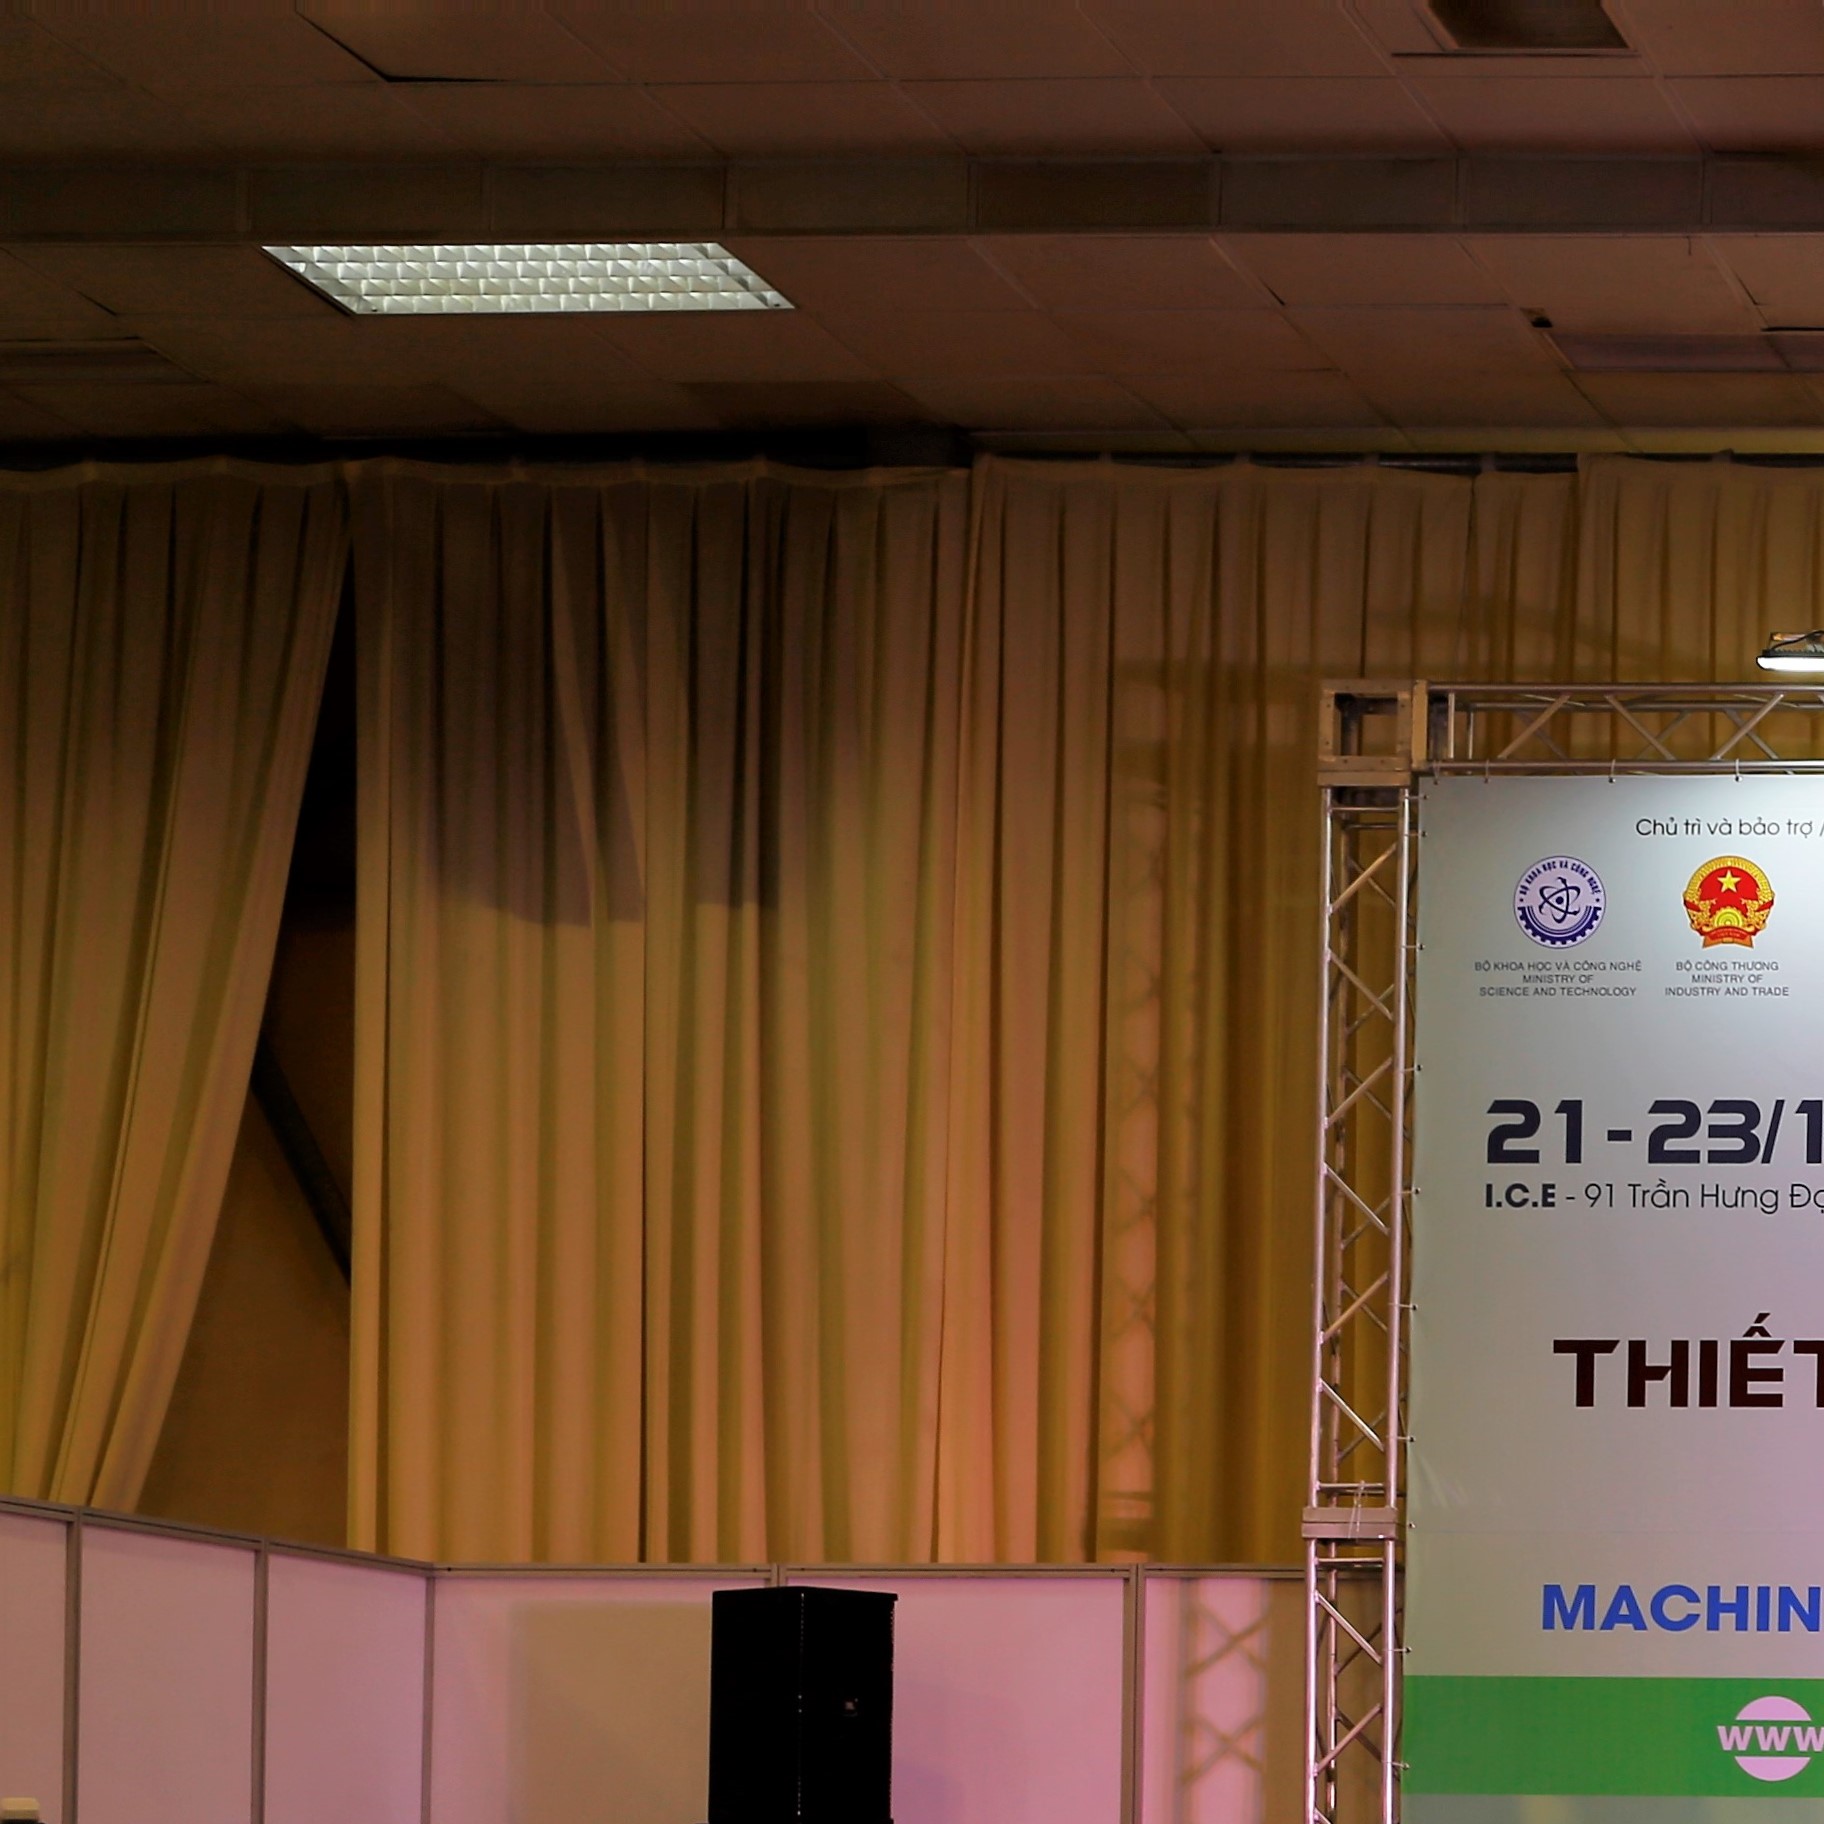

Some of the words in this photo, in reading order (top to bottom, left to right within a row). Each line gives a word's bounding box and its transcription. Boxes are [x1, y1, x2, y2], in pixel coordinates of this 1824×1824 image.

[1636, 817, 1678, 836] Chủ
[1683, 818, 1702, 836] trì
[1707, 818, 1733, 836] và
[1739, 817, 1781, 836] bảo
[1787, 820, 1813, 839] trợ
[1493, 961, 1525, 971] KHOA
[1555, 960, 1571, 971] VÀ
[1573, 959, 1607, 971] CÔNG
[1676, 959, 1692, 972] BỘ
[1694, 959, 1728, 971] CÔNG
[1522, 974, 1576, 984] MINISTRY
[1578, 974, 1594, 984] OF
[1691, 974, 1745, 984] MINISTRY
[1747, 974, 1764, 984] OF
[1479, 986, 1530, 997] SCIENCE
[1533, 986, 1557, 997] AND
[1560, 986, 1638, 997] TECHNOLOGY
[1664, 986, 1721, 997] INDUSTRY
[1724, 986, 1749, 997] AND
[1752, 986, 1790, 997] TRADE
[1485, 1182, 1556, 1209] I.C.E
[1584, 1182, 1614, 1208] 91
[1626, 1178, 1690, 1209] Trần
[1700, 1183, 1779, 1215] Hưng
